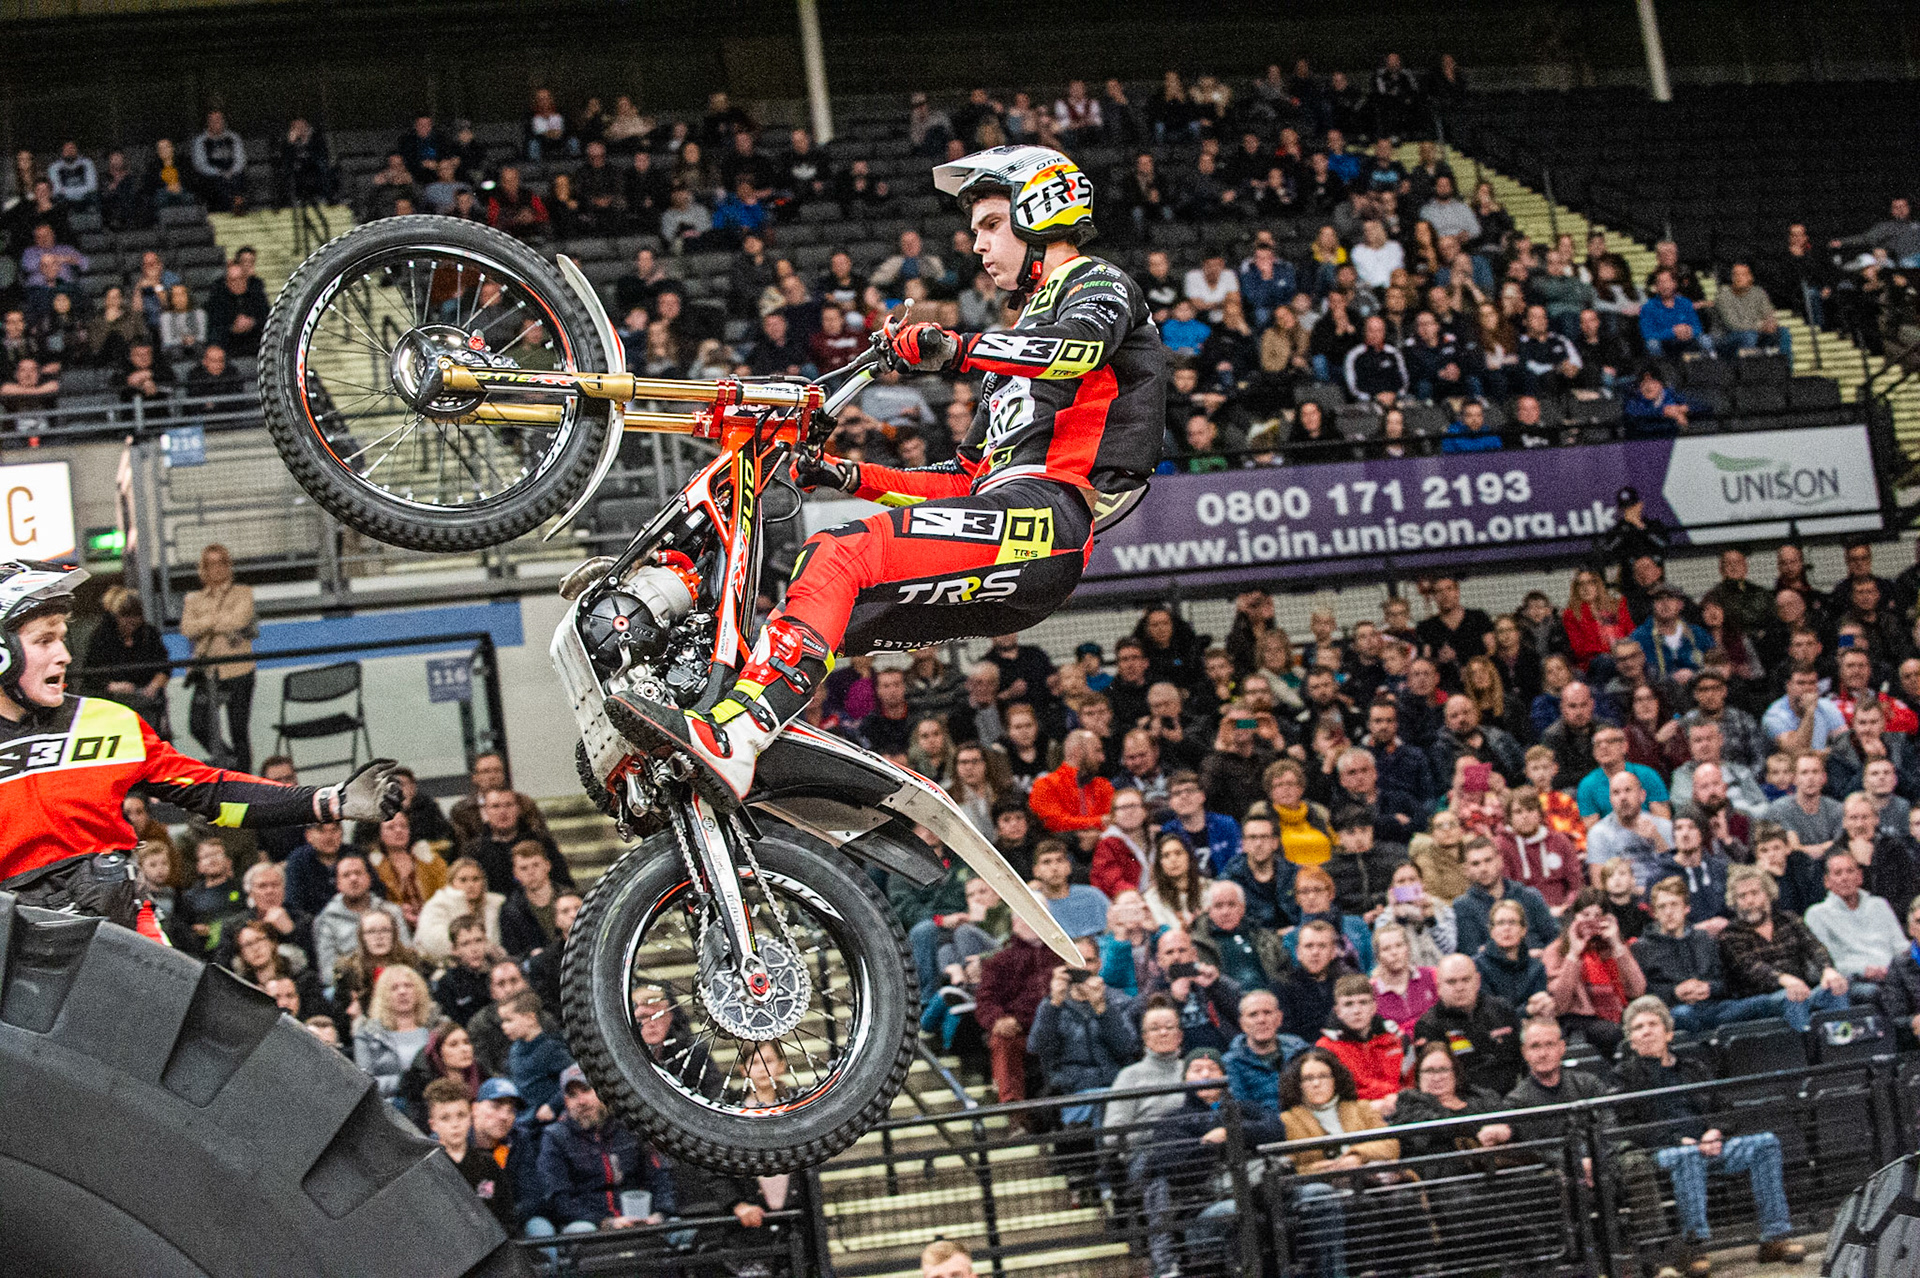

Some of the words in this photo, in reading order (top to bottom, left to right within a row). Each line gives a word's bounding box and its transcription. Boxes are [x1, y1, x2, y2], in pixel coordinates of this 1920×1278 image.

[1196, 486, 1311, 527] 0800
[1327, 480, 1404, 517] 171
[1421, 470, 1532, 511] 2193
[1721, 468, 1840, 503] UNISON
[6, 486, 37, 546] G
